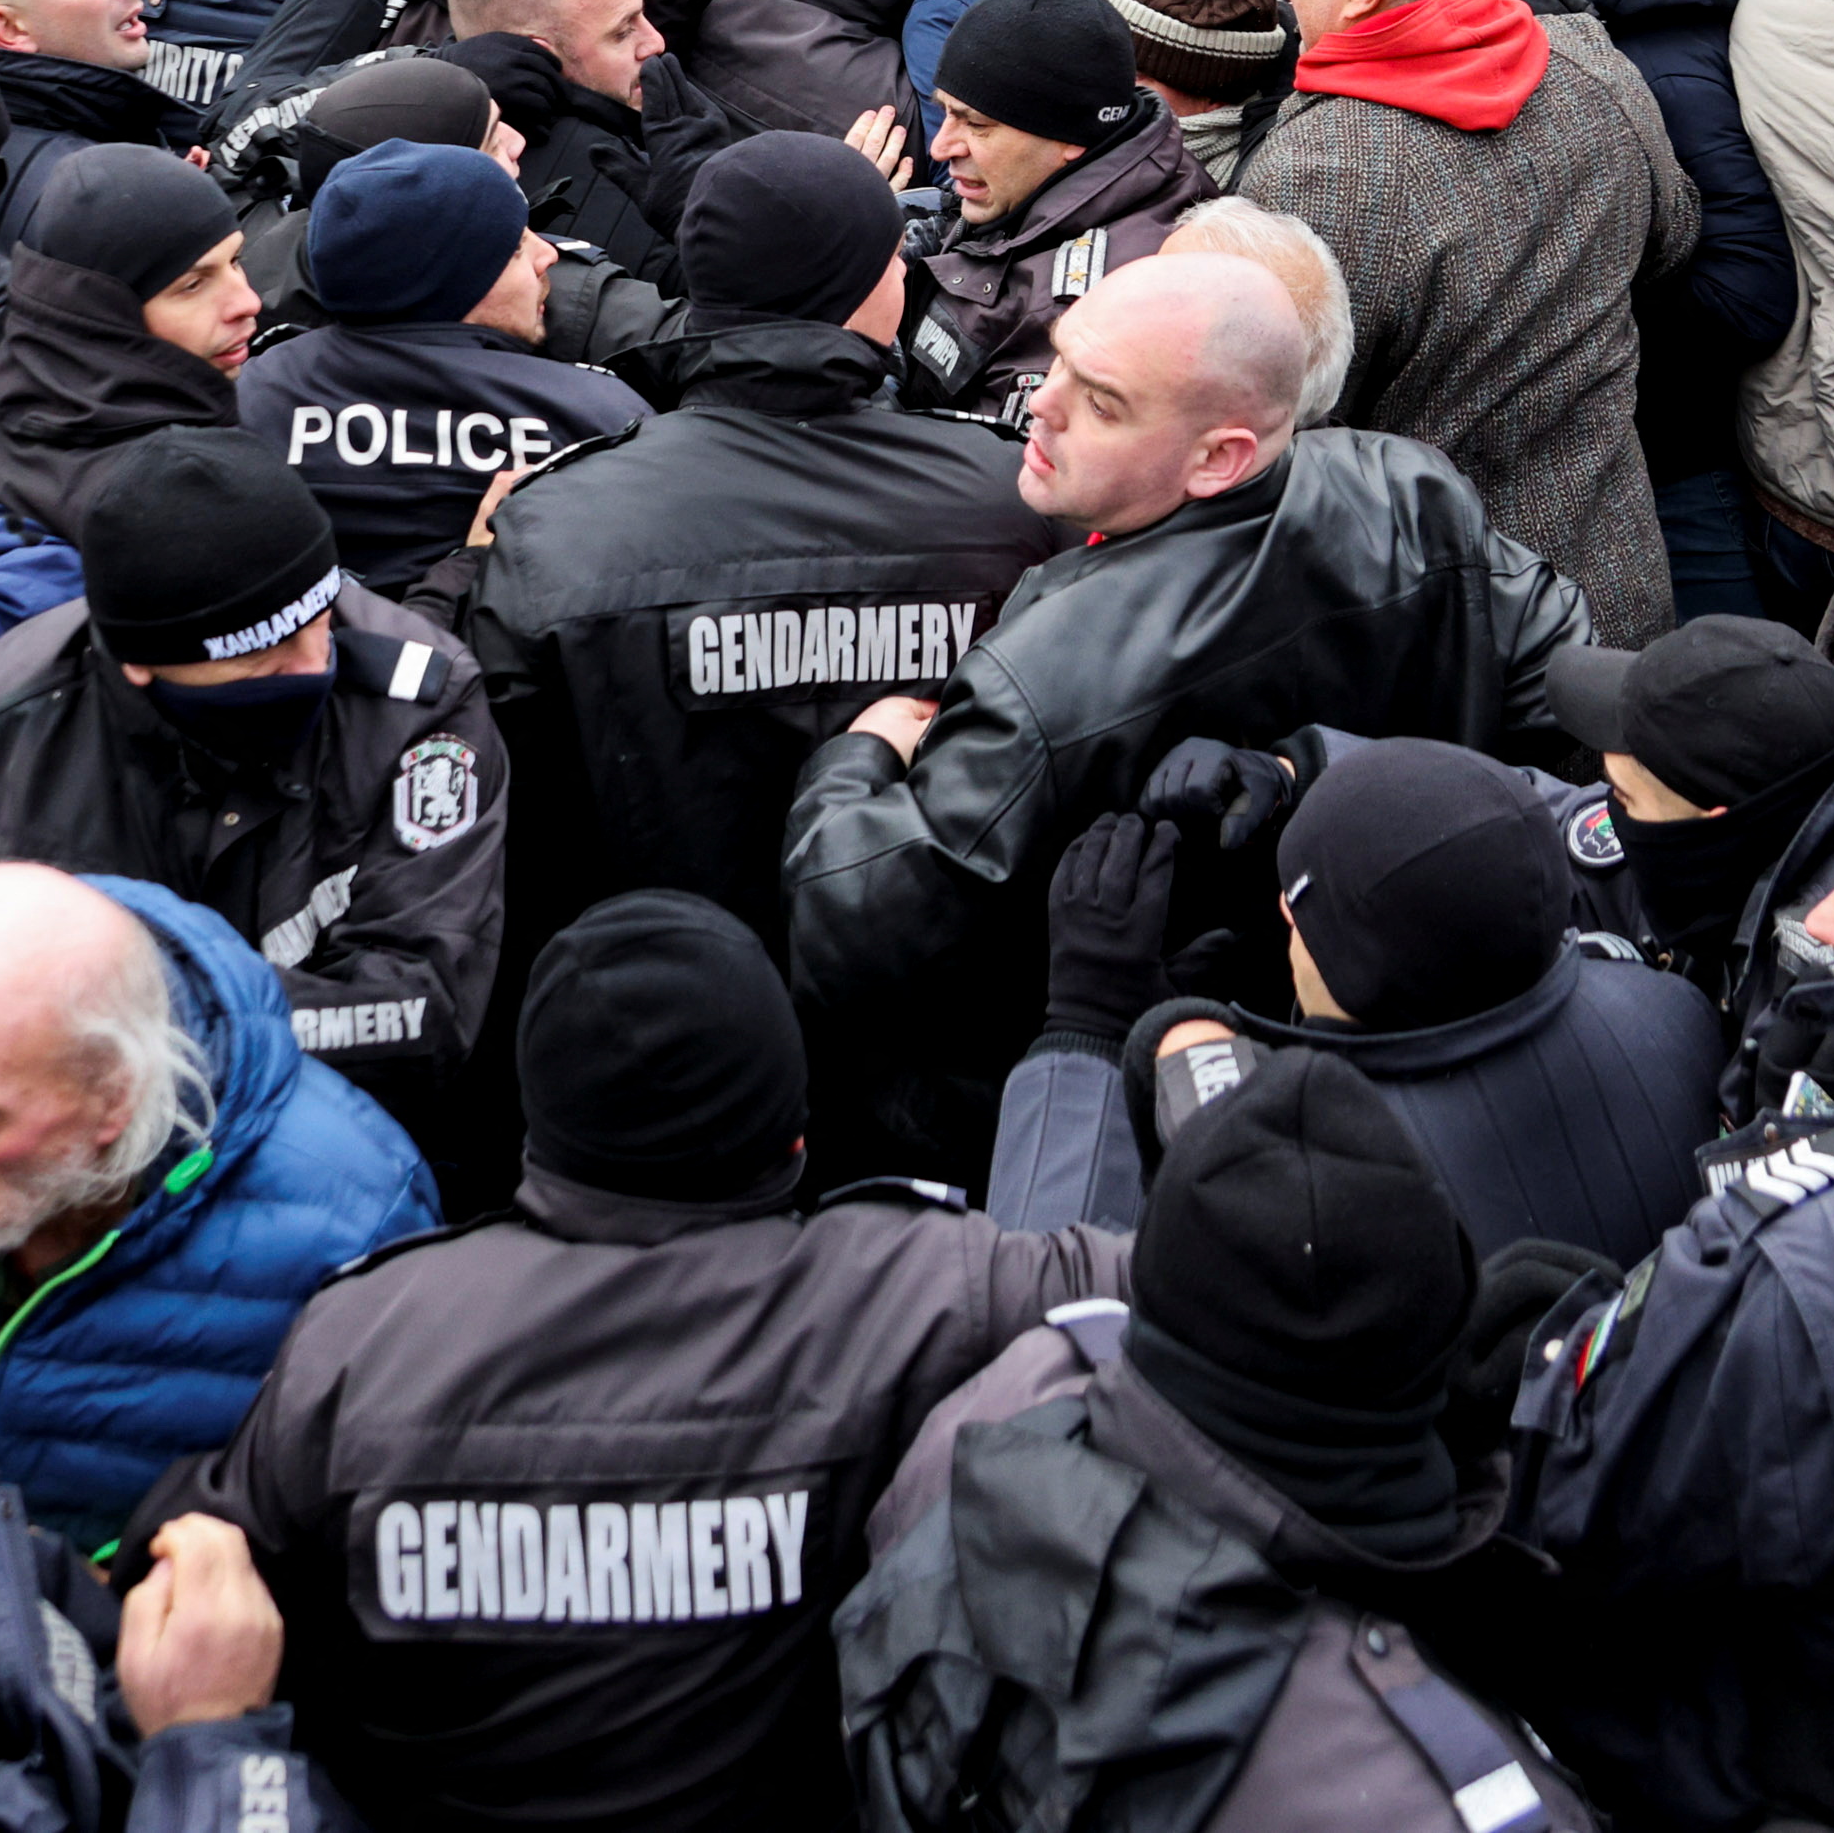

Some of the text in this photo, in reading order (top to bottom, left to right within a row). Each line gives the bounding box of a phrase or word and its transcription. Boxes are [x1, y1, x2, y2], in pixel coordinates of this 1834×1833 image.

[287, 403, 553, 472] POLICE
[689, 603, 977, 696] GENDARMERY
[376, 1489, 810, 1624] GENDARMERY
